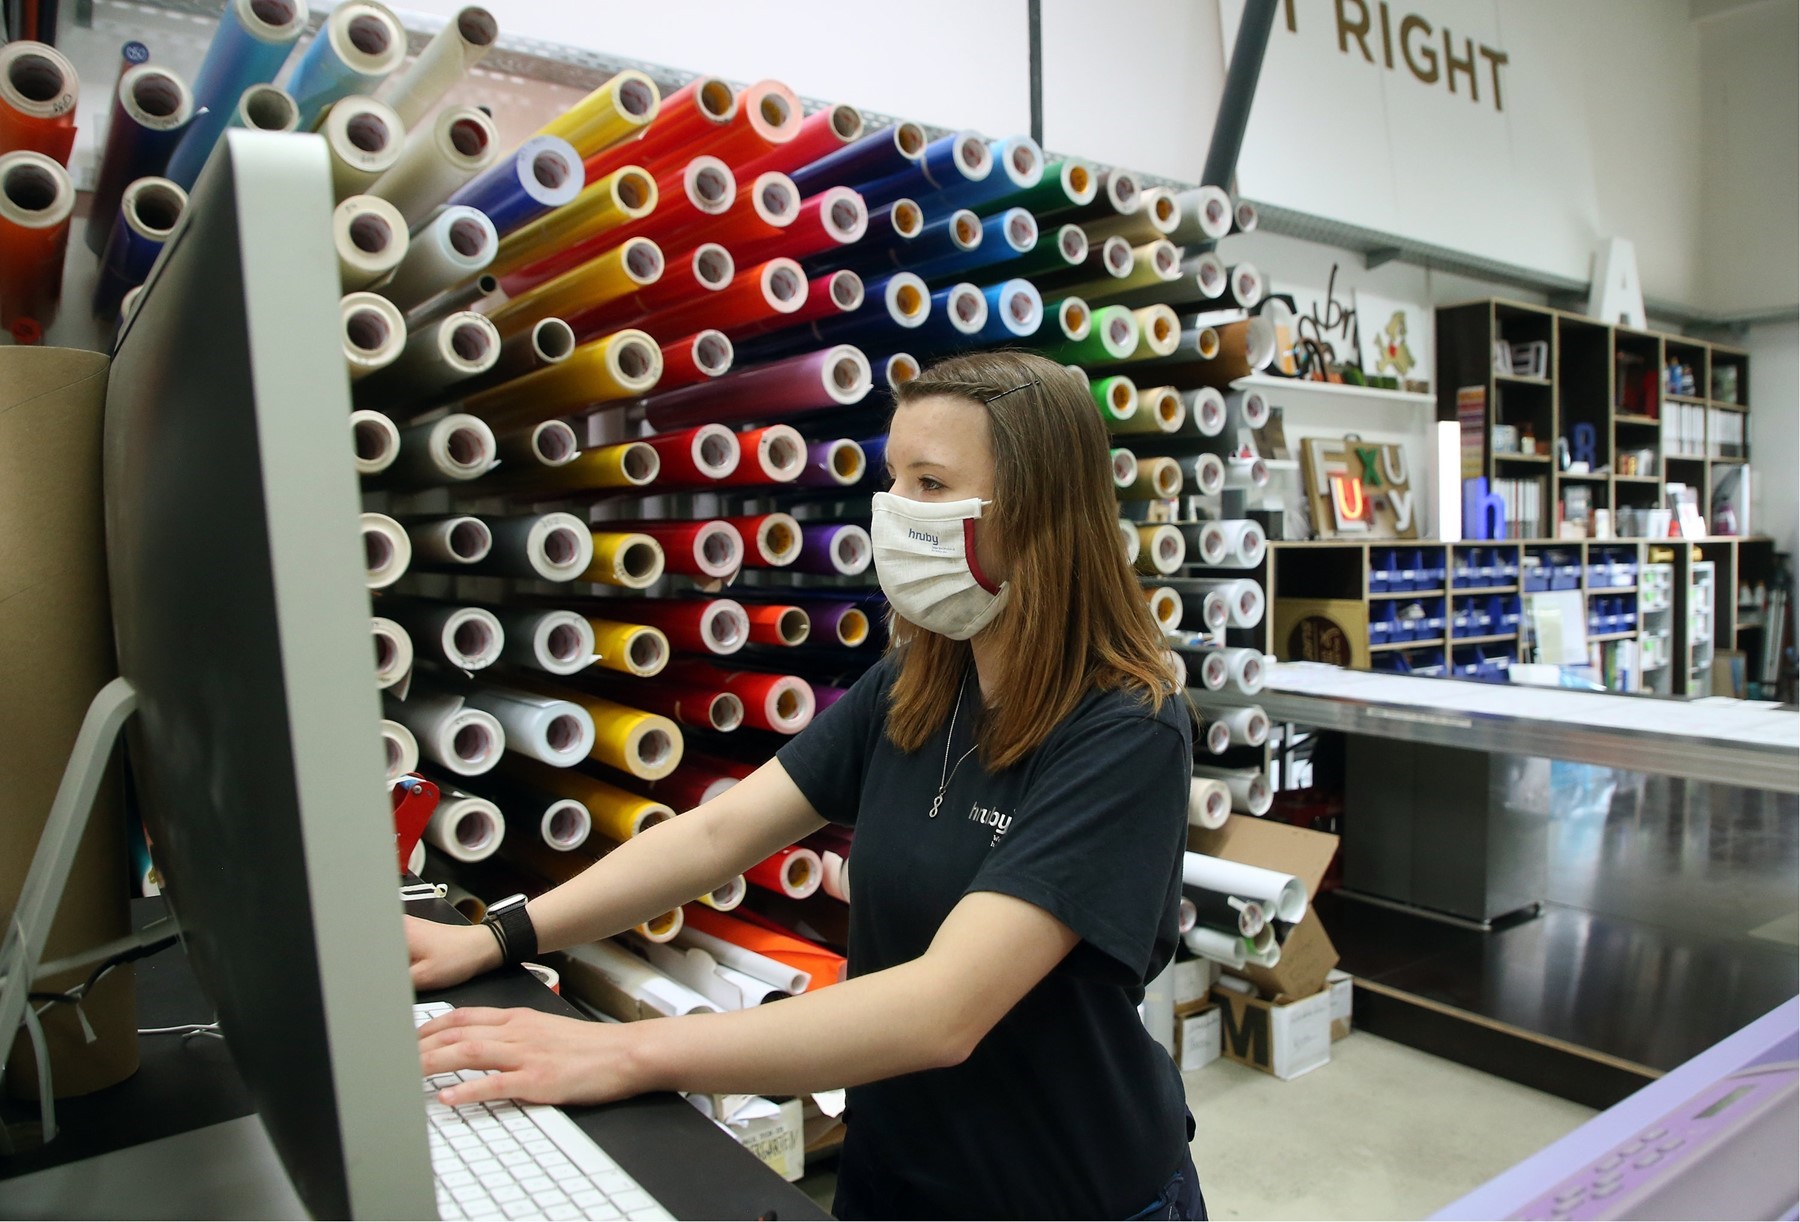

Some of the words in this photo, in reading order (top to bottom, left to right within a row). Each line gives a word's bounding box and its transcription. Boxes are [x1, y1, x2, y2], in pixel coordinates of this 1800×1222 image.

[1335, 0, 1508, 111] RIGHT
[908, 528, 939, 546] hruby
[968, 801, 1013, 835] hruby
[1210, 990, 1268, 1067] M
